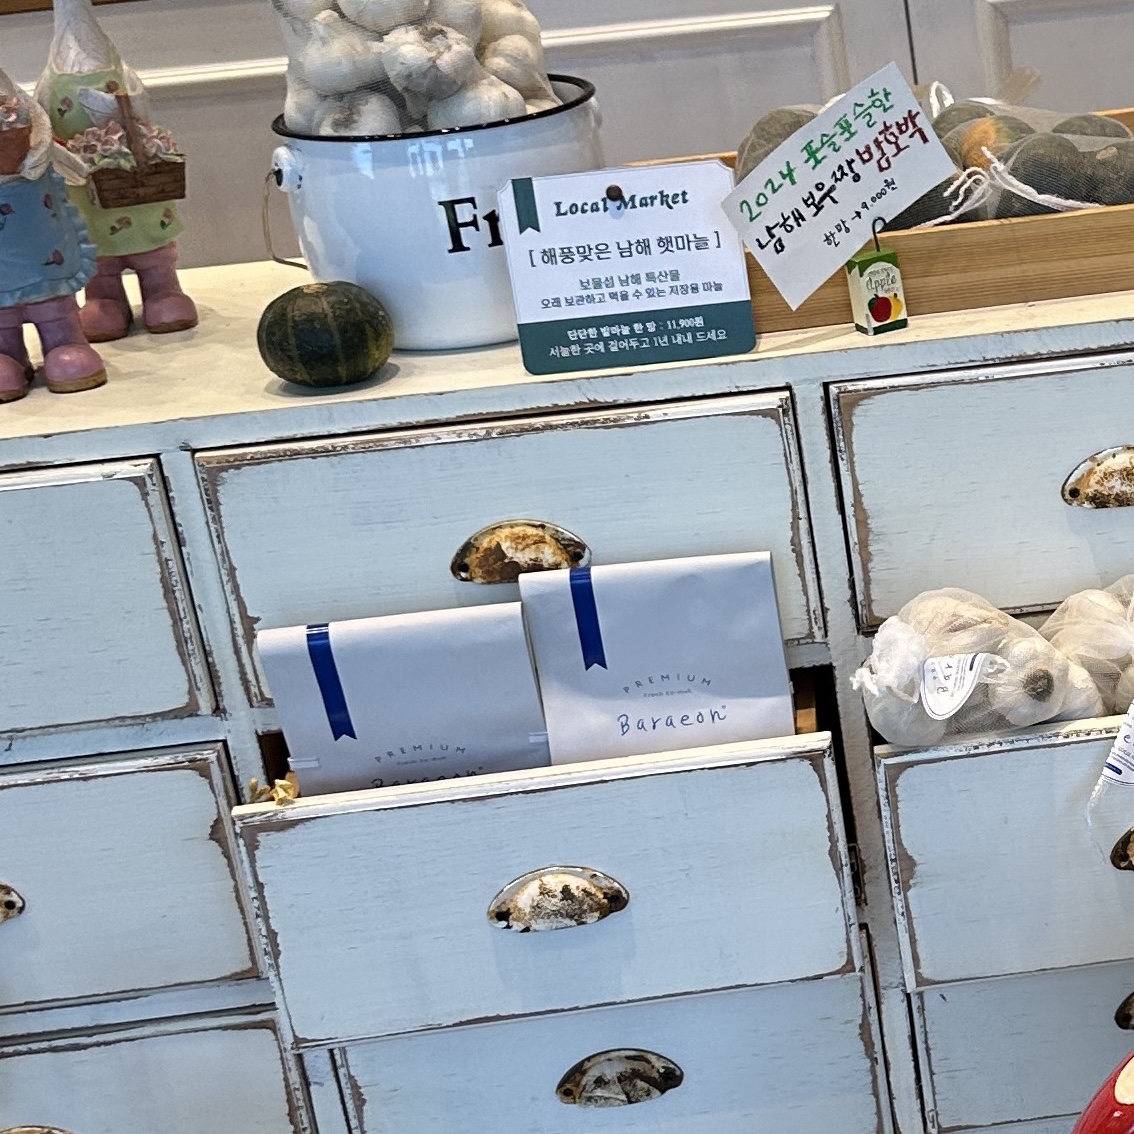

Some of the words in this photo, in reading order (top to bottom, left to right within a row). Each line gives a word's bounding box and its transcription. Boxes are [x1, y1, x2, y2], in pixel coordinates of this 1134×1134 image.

[740, 161, 797, 223] 2024
[801, 88, 894, 170] 포슬포슬한
[756, 208, 807, 255] 남해
[855, 109, 930, 173] 밤호박
[554, 197, 608, 216] Local
[616, 190, 690, 210] Market
[541, 242, 612, 266] 해풍맞은
[615, 238, 652, 258] 남해
[656, 233, 710, 254] 햇마늘
[579, 276, 615, 291] 보물섬
[617, 273, 642, 287] 남해
[645, 269, 681, 284] 특산물
[540, 297, 562, 309] 오래
[564, 293, 606, 307] 보관하고
[608, 290, 630, 302] 먹을
[632, 289, 643, 300] 수
[645, 287, 666, 298] 있는
[669, 283, 700, 296] 저장용
[702, 281, 723, 293] 마늘
[567, 327, 598, 341] 단단한
[633, 322, 644, 334] 한
[667, 316, 705, 331] 11,900원
[549, 344, 581, 358] 서늘한
[584, 341, 605, 355] 곳에
[608, 337, 651, 352] 걸어두고
[653, 334, 670, 347] 1년
[671, 332, 693, 345] 내내
[695, 329, 728, 342] 드세요
[622, 673, 711, 694] PREMIUM
[617, 707, 727, 736] Baraeon
[374, 743, 466, 763] PREMIUM
